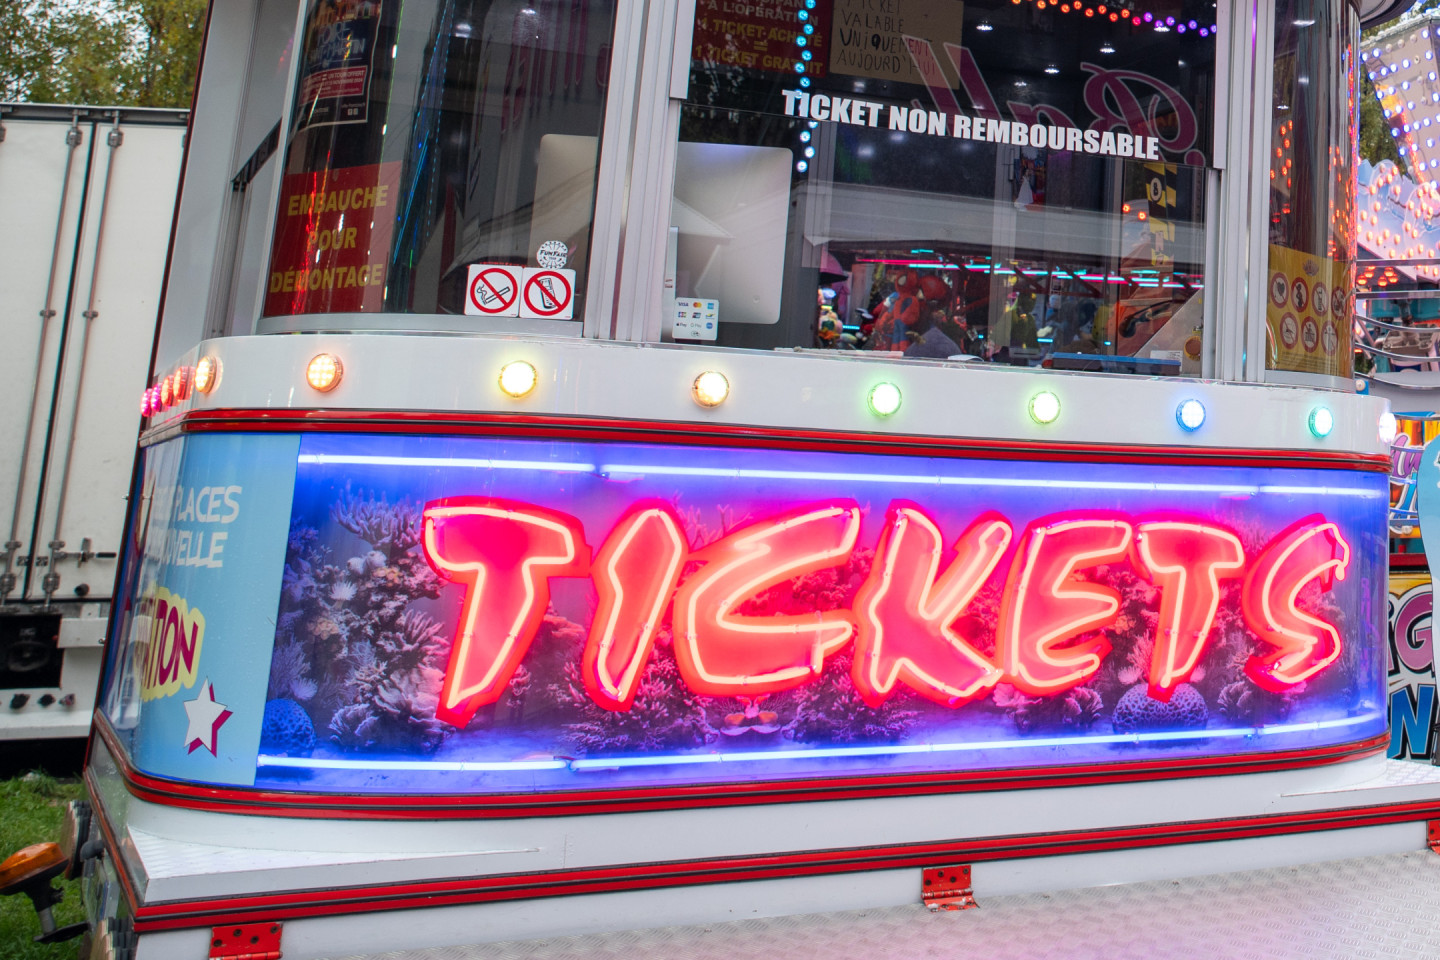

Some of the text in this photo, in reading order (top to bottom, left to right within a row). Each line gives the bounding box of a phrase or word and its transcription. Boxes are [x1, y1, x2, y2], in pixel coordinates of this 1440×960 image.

[713, 19, 763, 38] TICKET
[768, 27, 823, 47] ACHTÉ
[841, 8, 905, 33] VALABLE
[782, 89, 1160, 161] TICKET NON REMBOURSABLE
[288, 185, 389, 216] EMBAUCHE
[308, 227, 358, 253] POUR
[270, 263, 384, 293] DÉMONTAGE
[422, 495, 1352, 728] TICKETS
